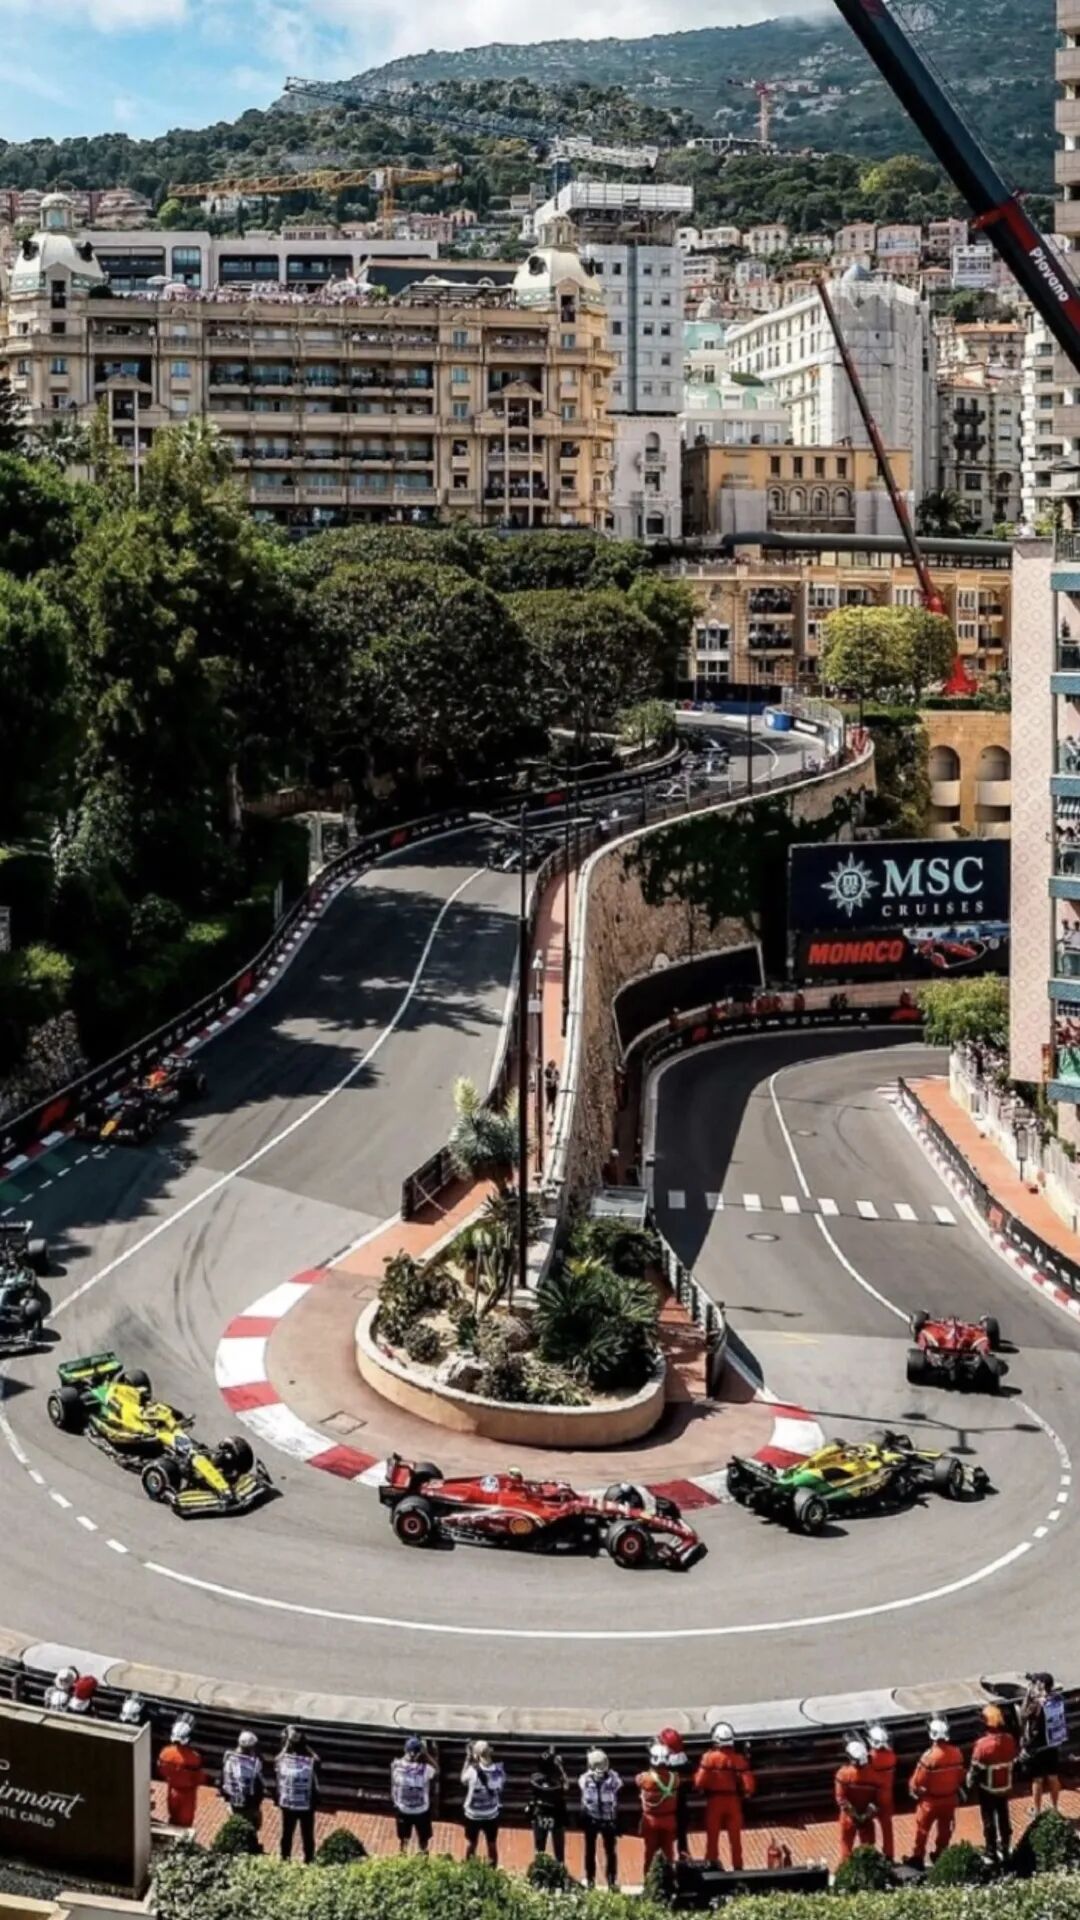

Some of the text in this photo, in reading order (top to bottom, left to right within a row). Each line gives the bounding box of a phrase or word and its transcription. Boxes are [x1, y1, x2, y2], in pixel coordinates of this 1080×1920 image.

[882, 856, 984, 898] MSC
[882, 901, 984, 917] CRUISES
[808, 940, 905, 966] MONACO
[19, 1811, 57, 1829] CARLO
